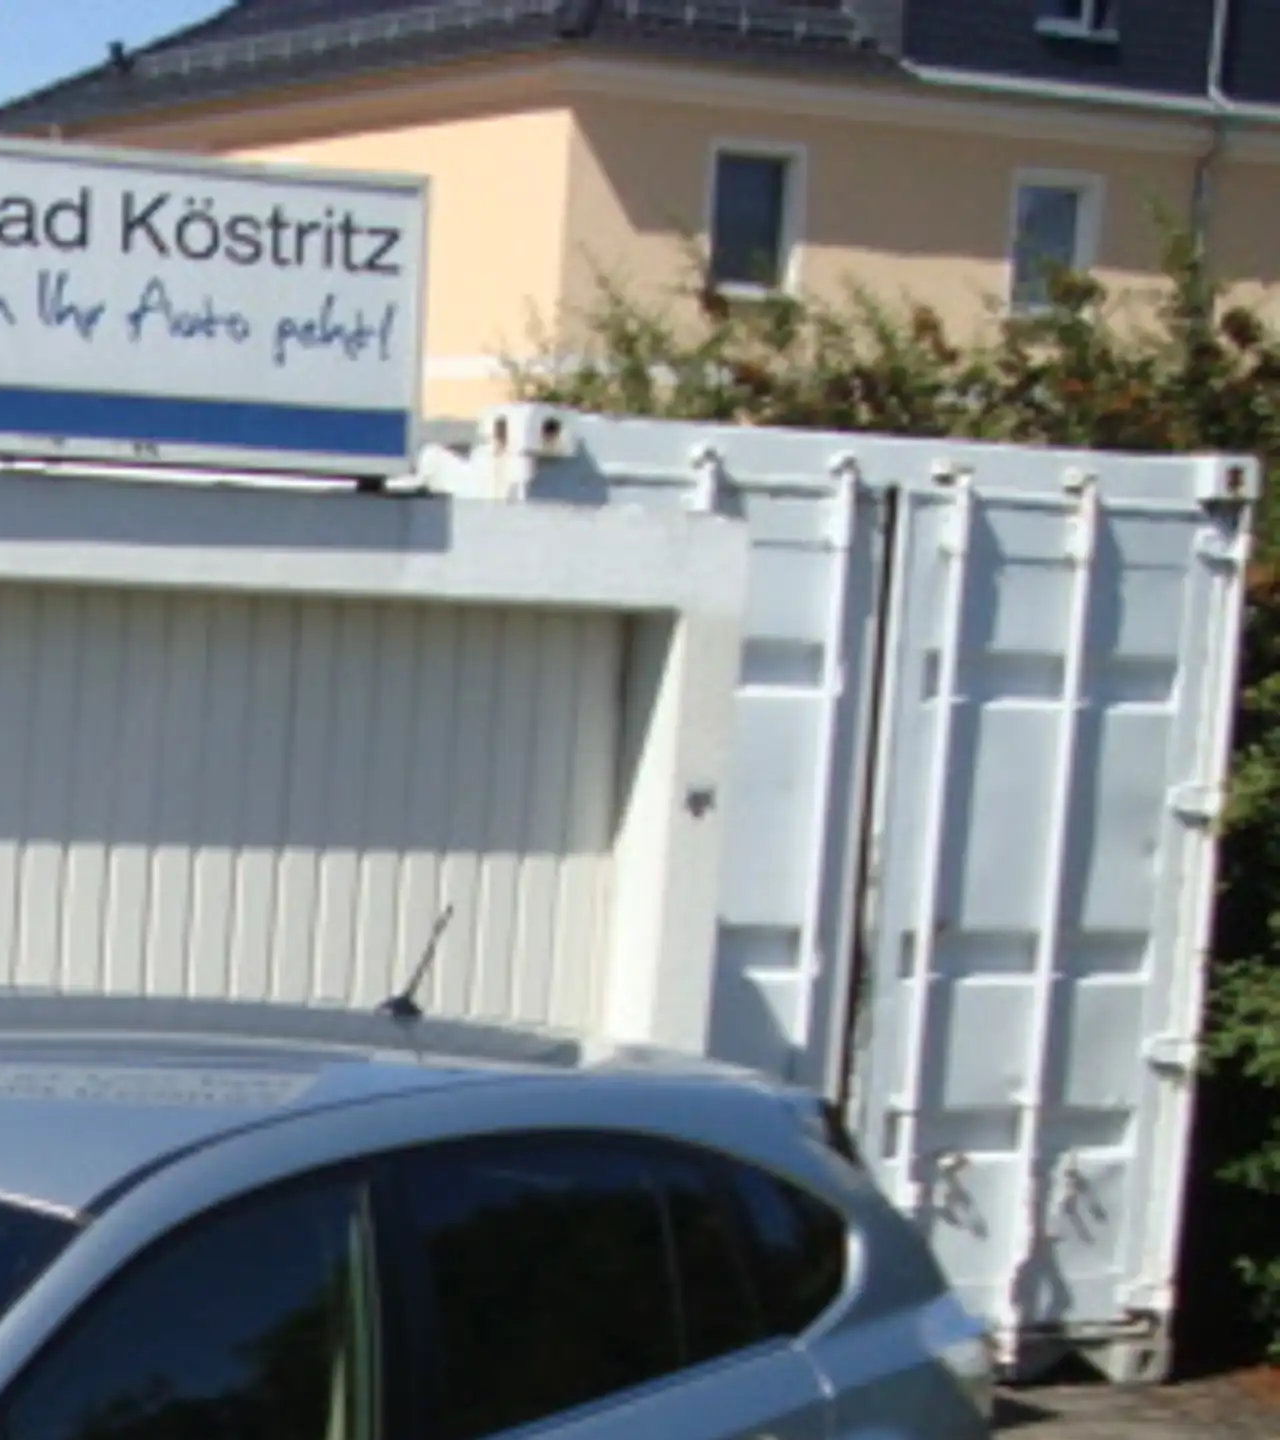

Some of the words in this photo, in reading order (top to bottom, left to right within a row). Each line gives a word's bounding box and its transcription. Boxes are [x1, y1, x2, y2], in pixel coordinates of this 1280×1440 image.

[120, 191, 403, 278] Köstritz
[36, 269, 107, 340] Ihr
[125, 275, 251, 344] Auto
